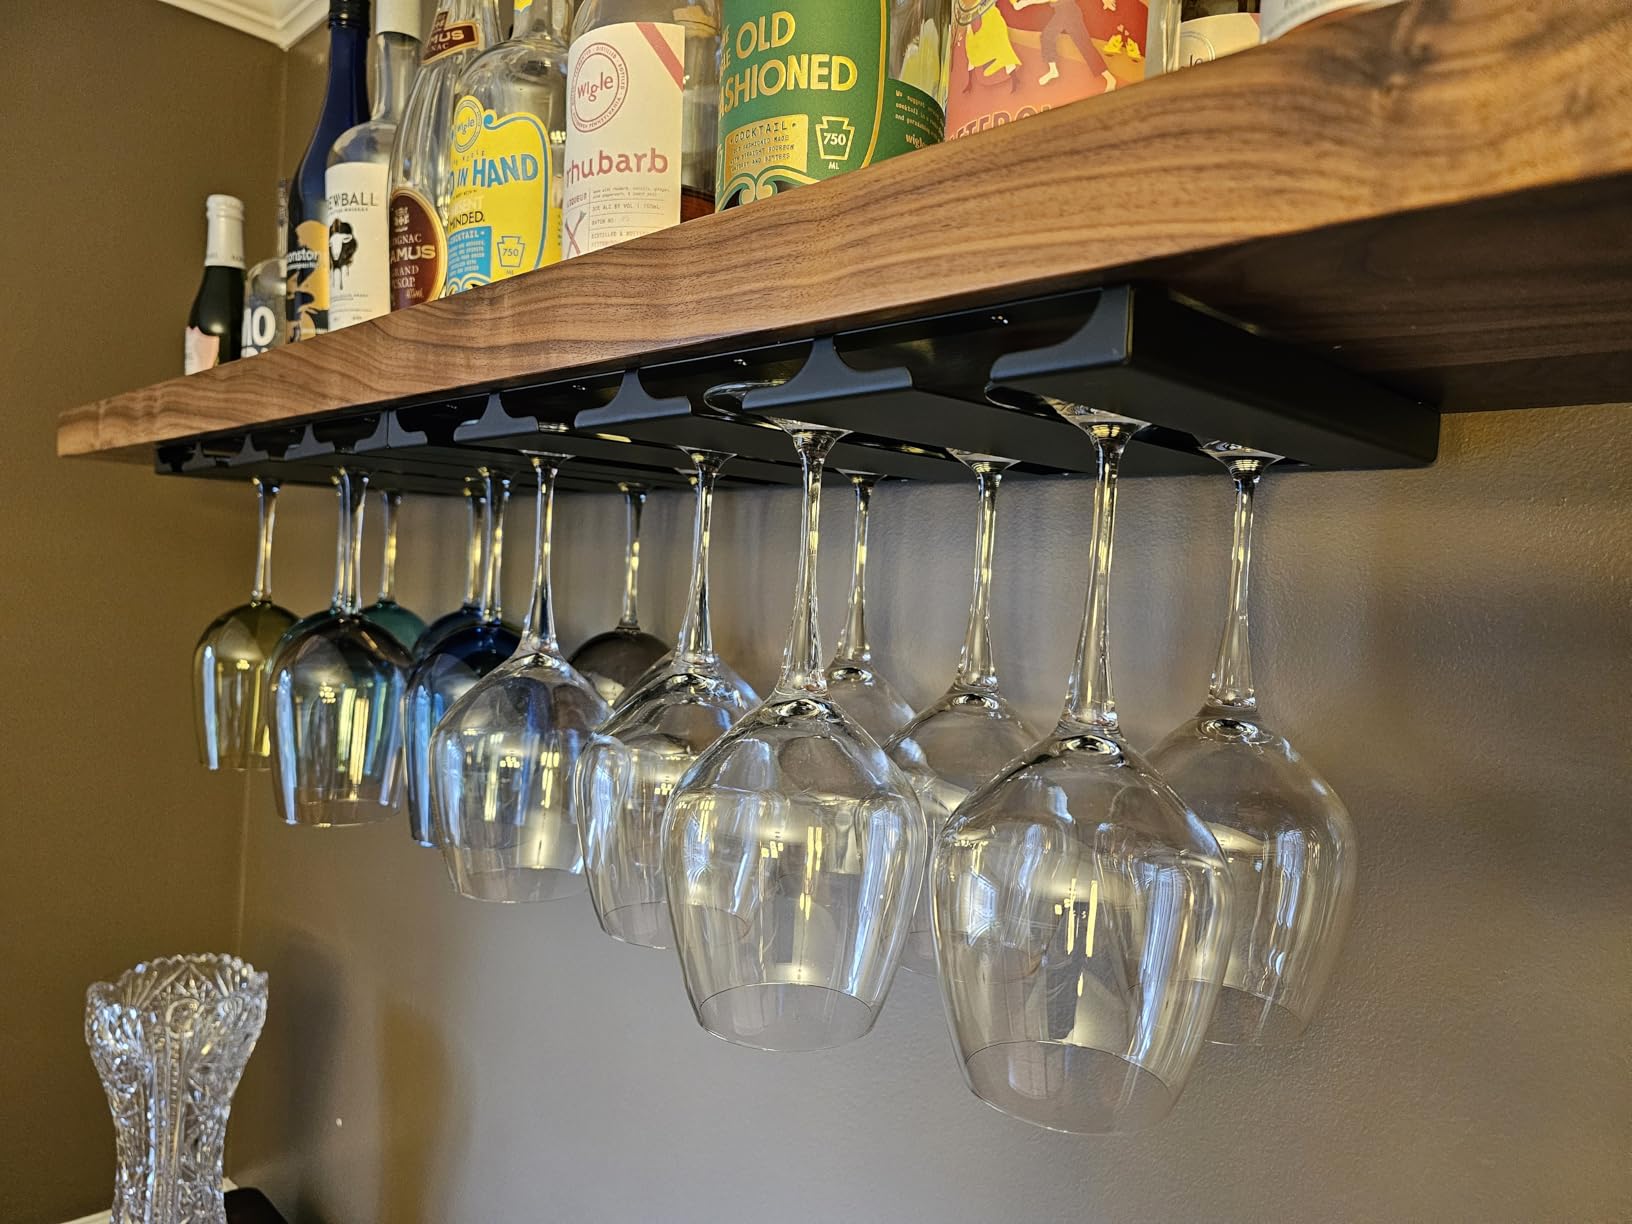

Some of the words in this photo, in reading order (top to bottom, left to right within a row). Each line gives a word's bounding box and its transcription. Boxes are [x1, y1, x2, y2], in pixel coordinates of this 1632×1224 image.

[736, 11, 796, 59] OLD
[734, 121, 787, 144] COCKTAIL
[823, 132, 847, 146] 750
[472, 153, 539, 188] HAND
[566, 147, 669, 188] rhubarb
[828, 161, 840, 170] ML
[502, 248, 519, 257] 750
